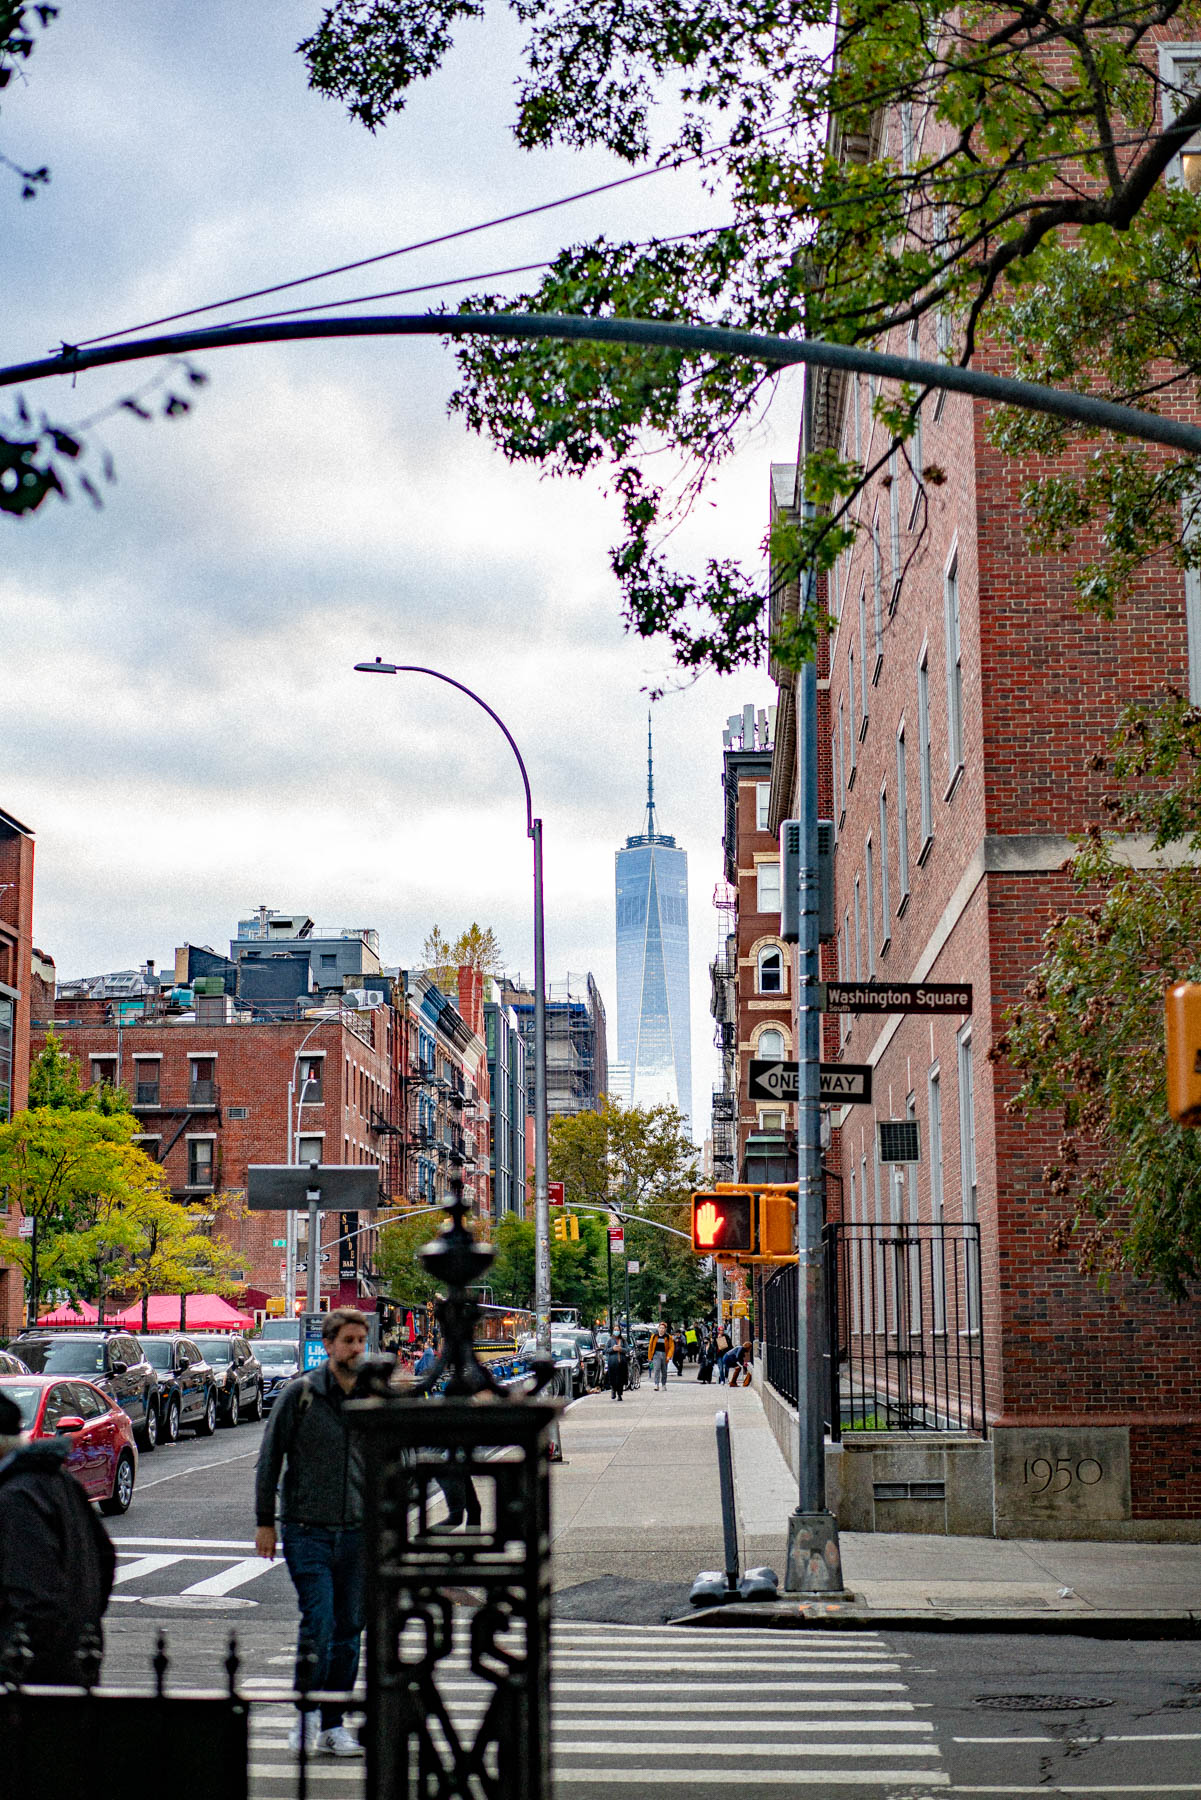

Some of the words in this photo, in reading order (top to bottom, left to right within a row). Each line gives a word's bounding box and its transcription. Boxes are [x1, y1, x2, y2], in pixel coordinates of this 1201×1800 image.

[828, 989, 911, 1008] Washington
[916, 990, 969, 1008] Square
[829, 1004, 851, 1012] South
[768, 1073, 799, 1089] ONE
[820, 1075, 856, 1091] WAY
[308, 1345, 328, 1356] Lik
[1023, 1457, 1103, 1494] 1950
